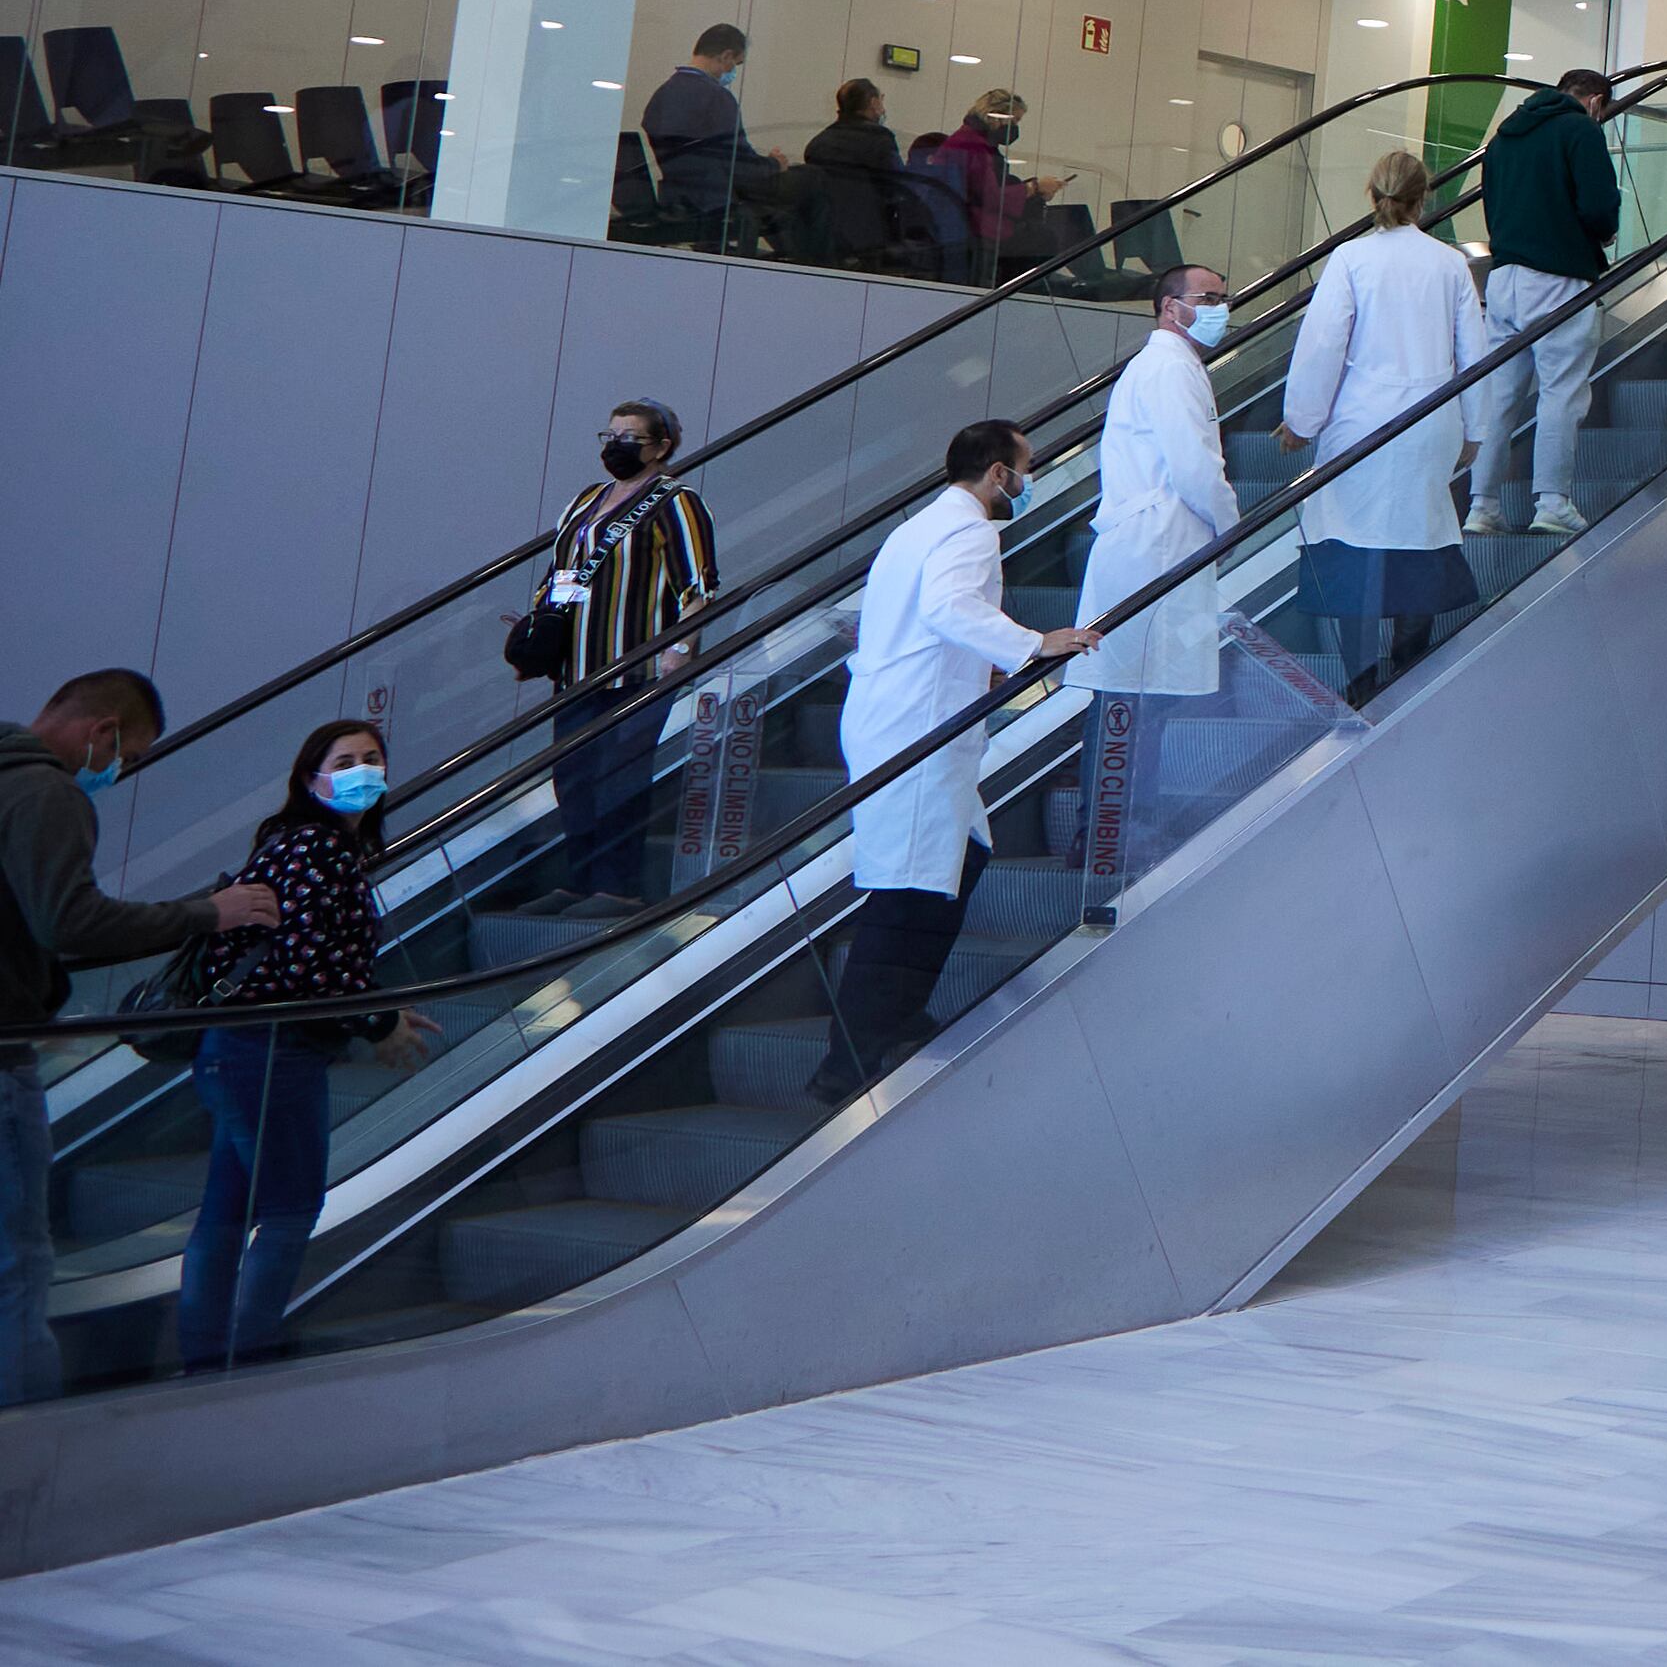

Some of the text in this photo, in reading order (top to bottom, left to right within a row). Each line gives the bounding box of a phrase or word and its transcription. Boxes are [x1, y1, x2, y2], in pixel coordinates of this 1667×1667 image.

[681, 729, 715, 855] NO CLIMBING
[719, 732, 752, 858] NO CLIMBING
[1093, 741, 1128, 876] NO CLIMBING
